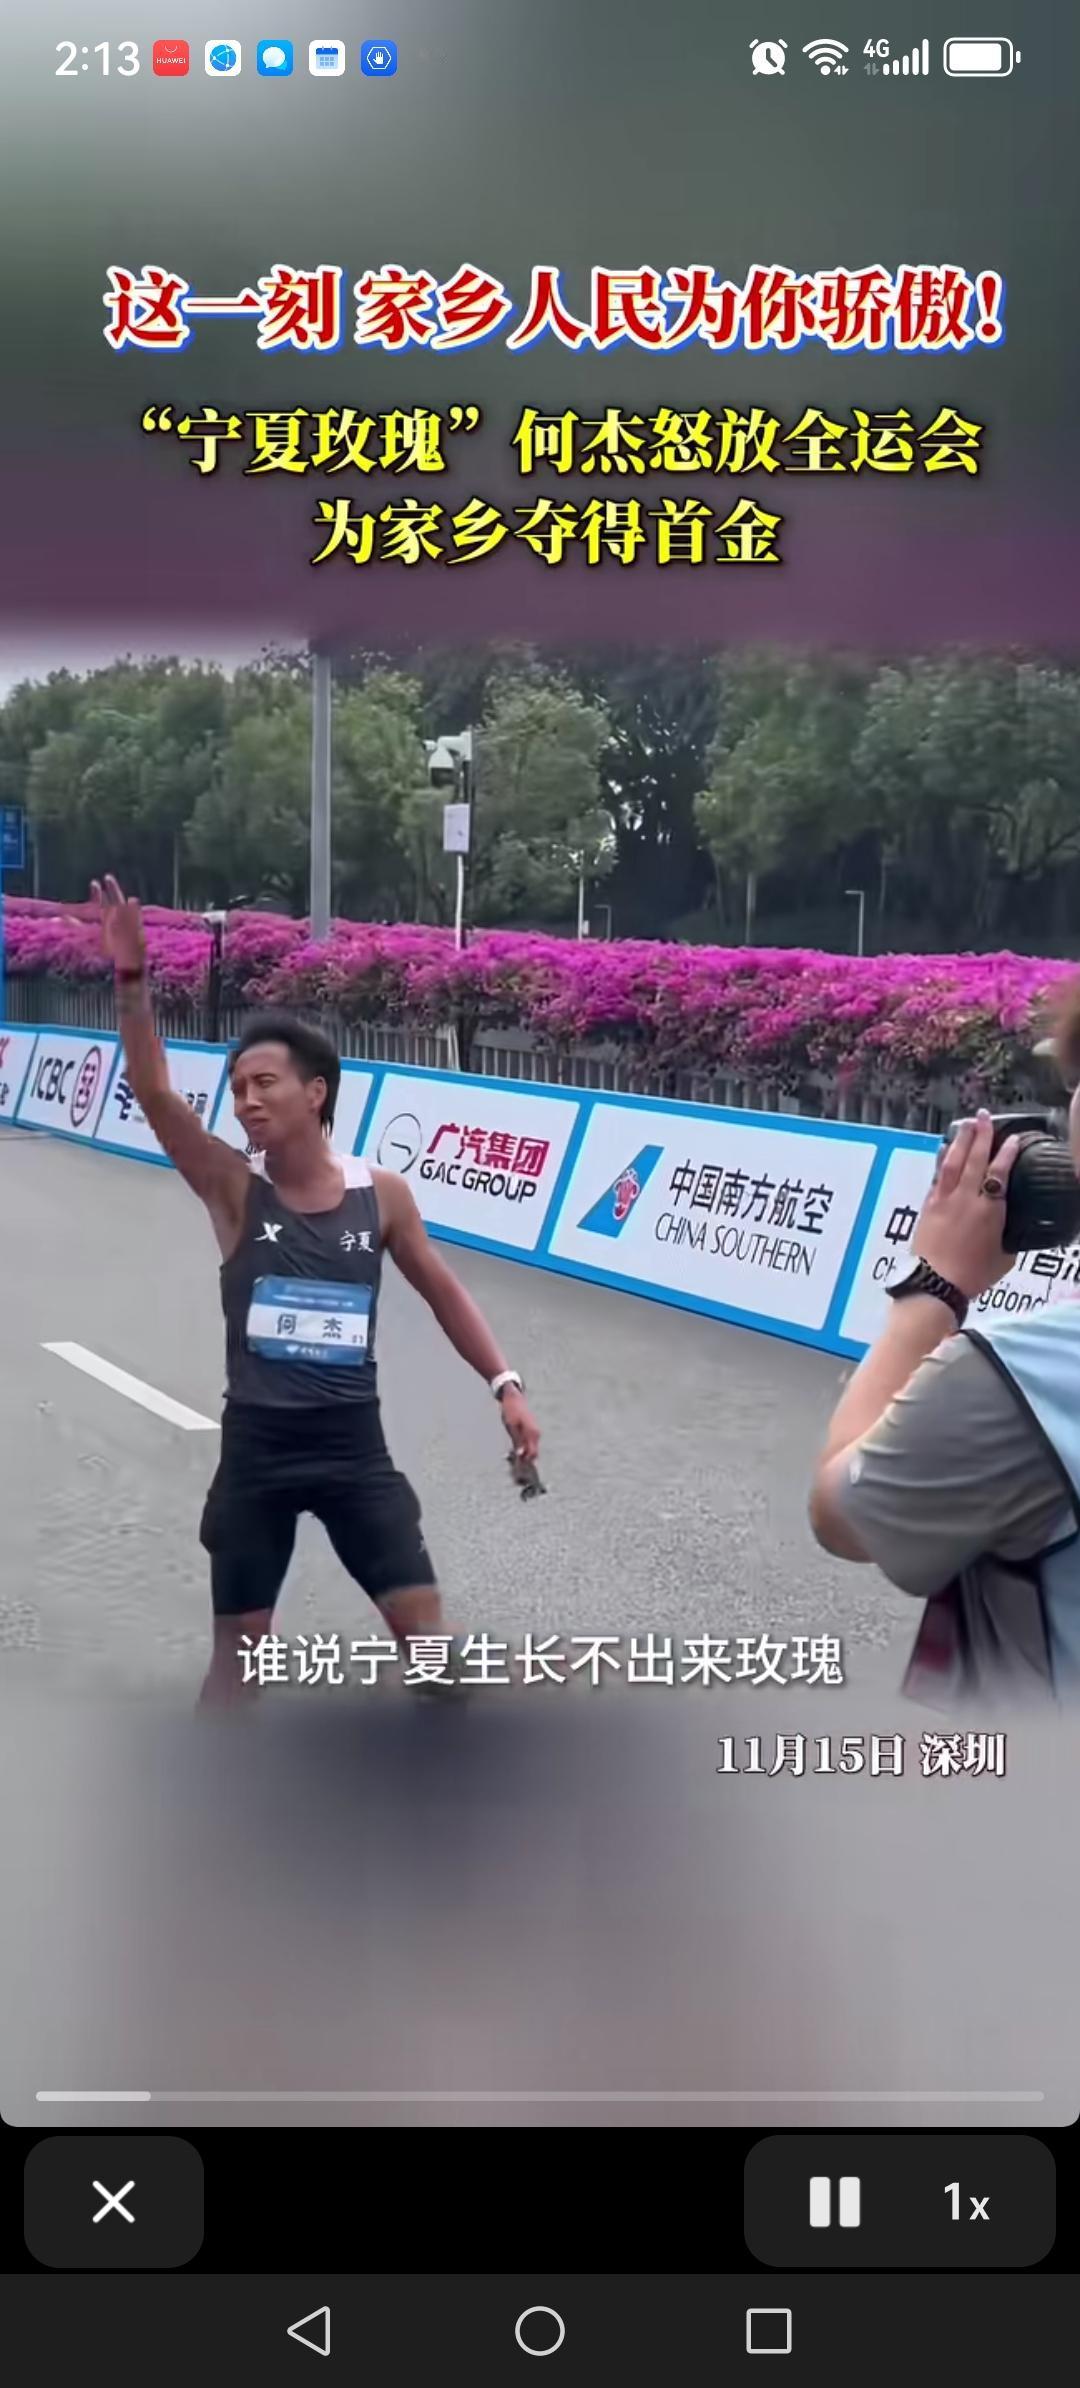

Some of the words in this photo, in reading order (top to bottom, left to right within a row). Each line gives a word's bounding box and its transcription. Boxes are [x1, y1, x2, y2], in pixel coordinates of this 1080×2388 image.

[56, 41, 140, 76] 2:13
[863, 38, 890, 58] 4G
[31, 1056, 75, 1104] ICBC
[427, 1123, 550, 1177] 广汽集团
[420, 1159, 461, 1185] GAC
[462, 1168, 537, 1203] GROUP
[669, 1158, 834, 1235] 中国南方航空
[339, 1230, 374, 1252] 宁夏
[655, 1212, 708, 1251] CHINA
[710, 1225, 817, 1277] SOUTHERN
[944, 2182, 990, 2221] 1x
